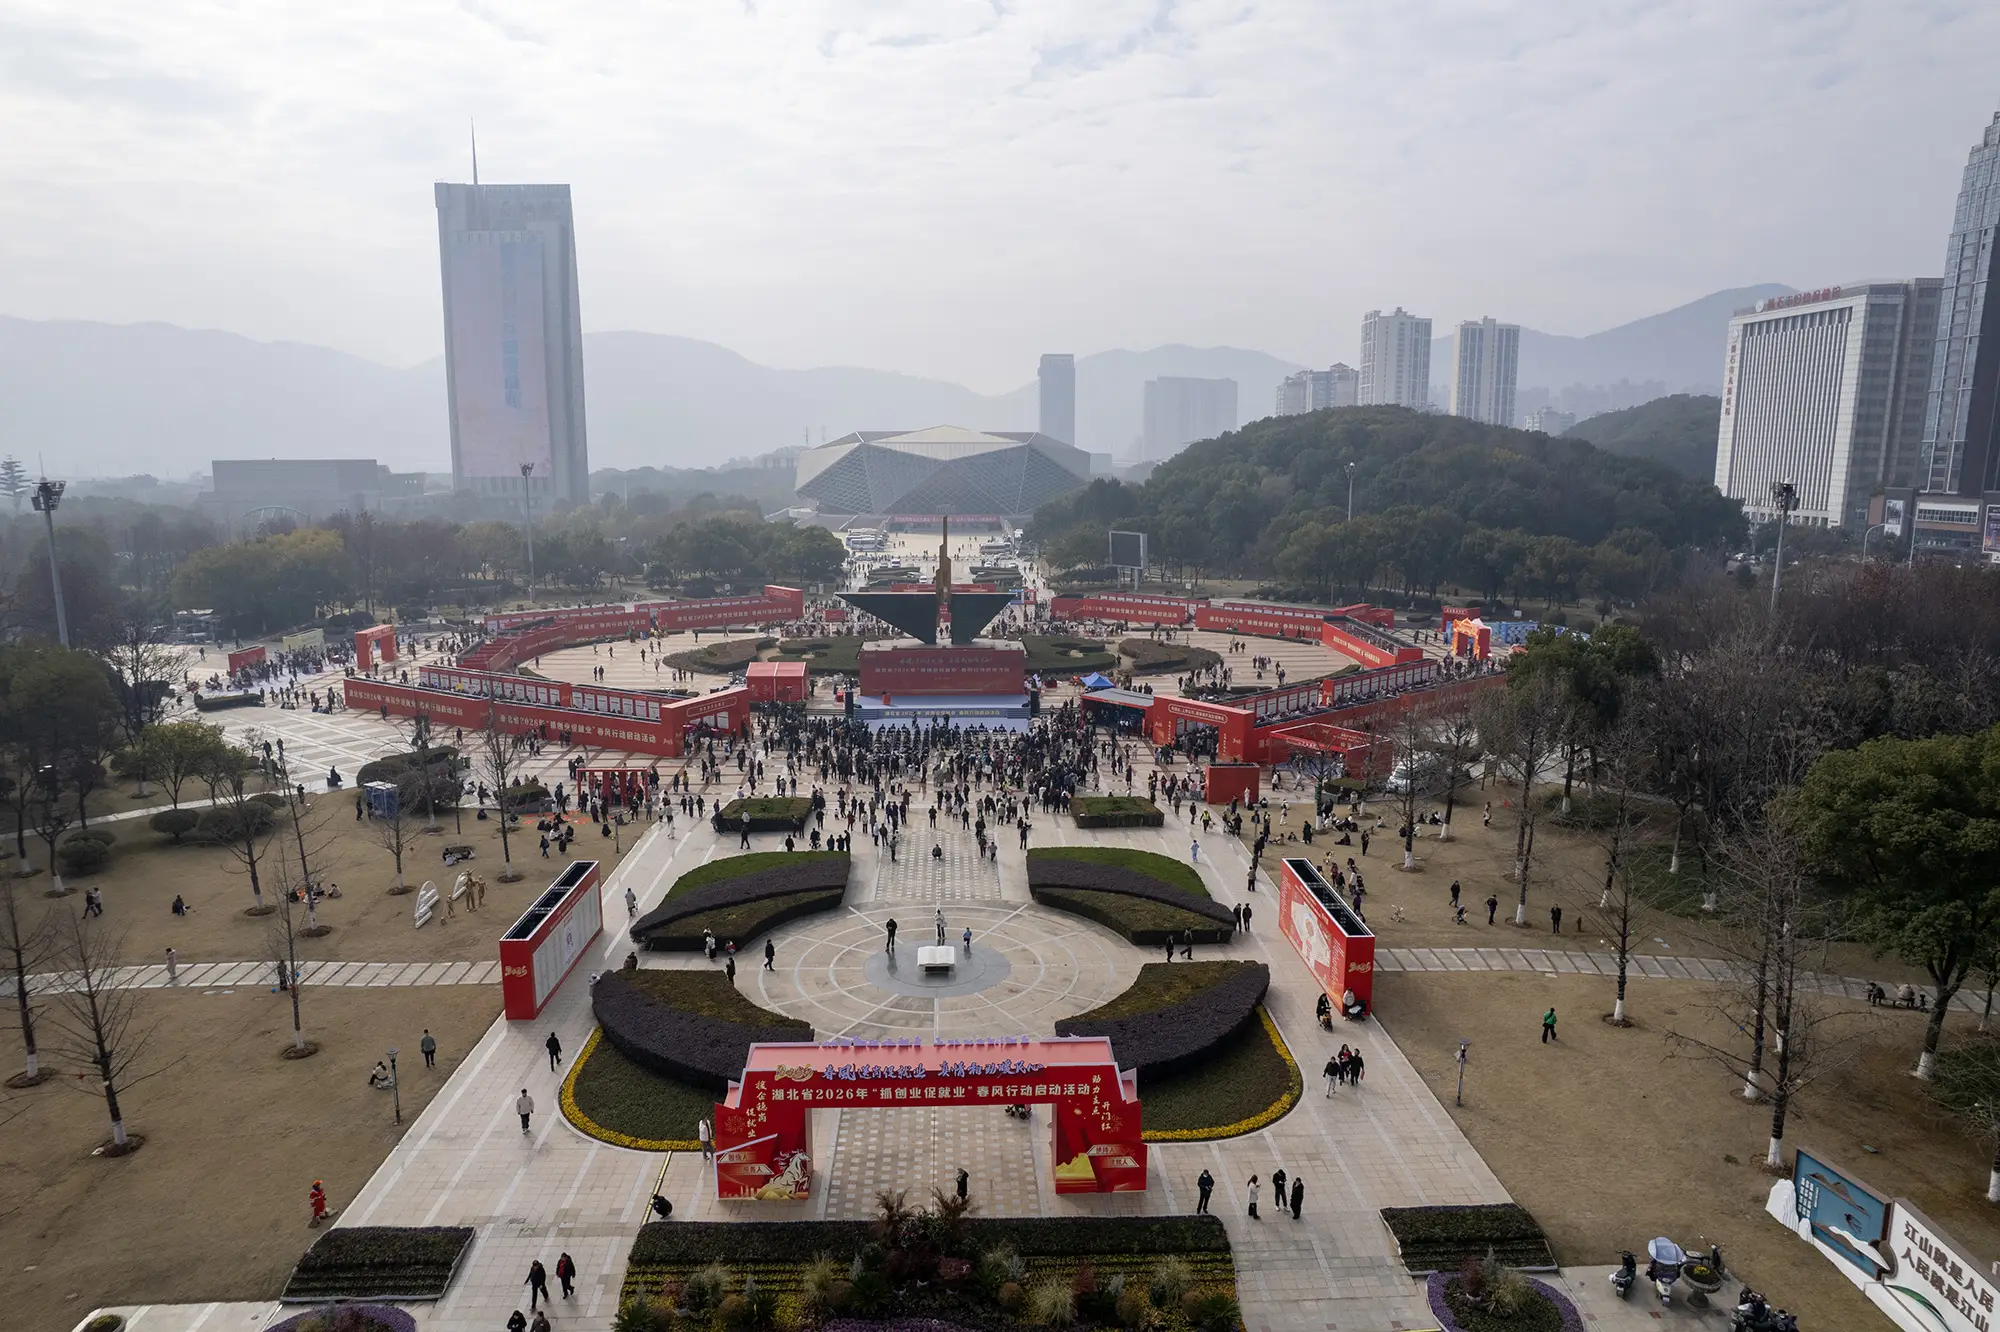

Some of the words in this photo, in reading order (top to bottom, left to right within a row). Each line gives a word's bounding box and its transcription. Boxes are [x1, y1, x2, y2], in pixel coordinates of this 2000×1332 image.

[745, 1108, 757, 1138] 促就业
[1900, 1246, 1990, 1332] 人民就是江山
[1903, 1220, 1995, 1314] 江山就是人民
